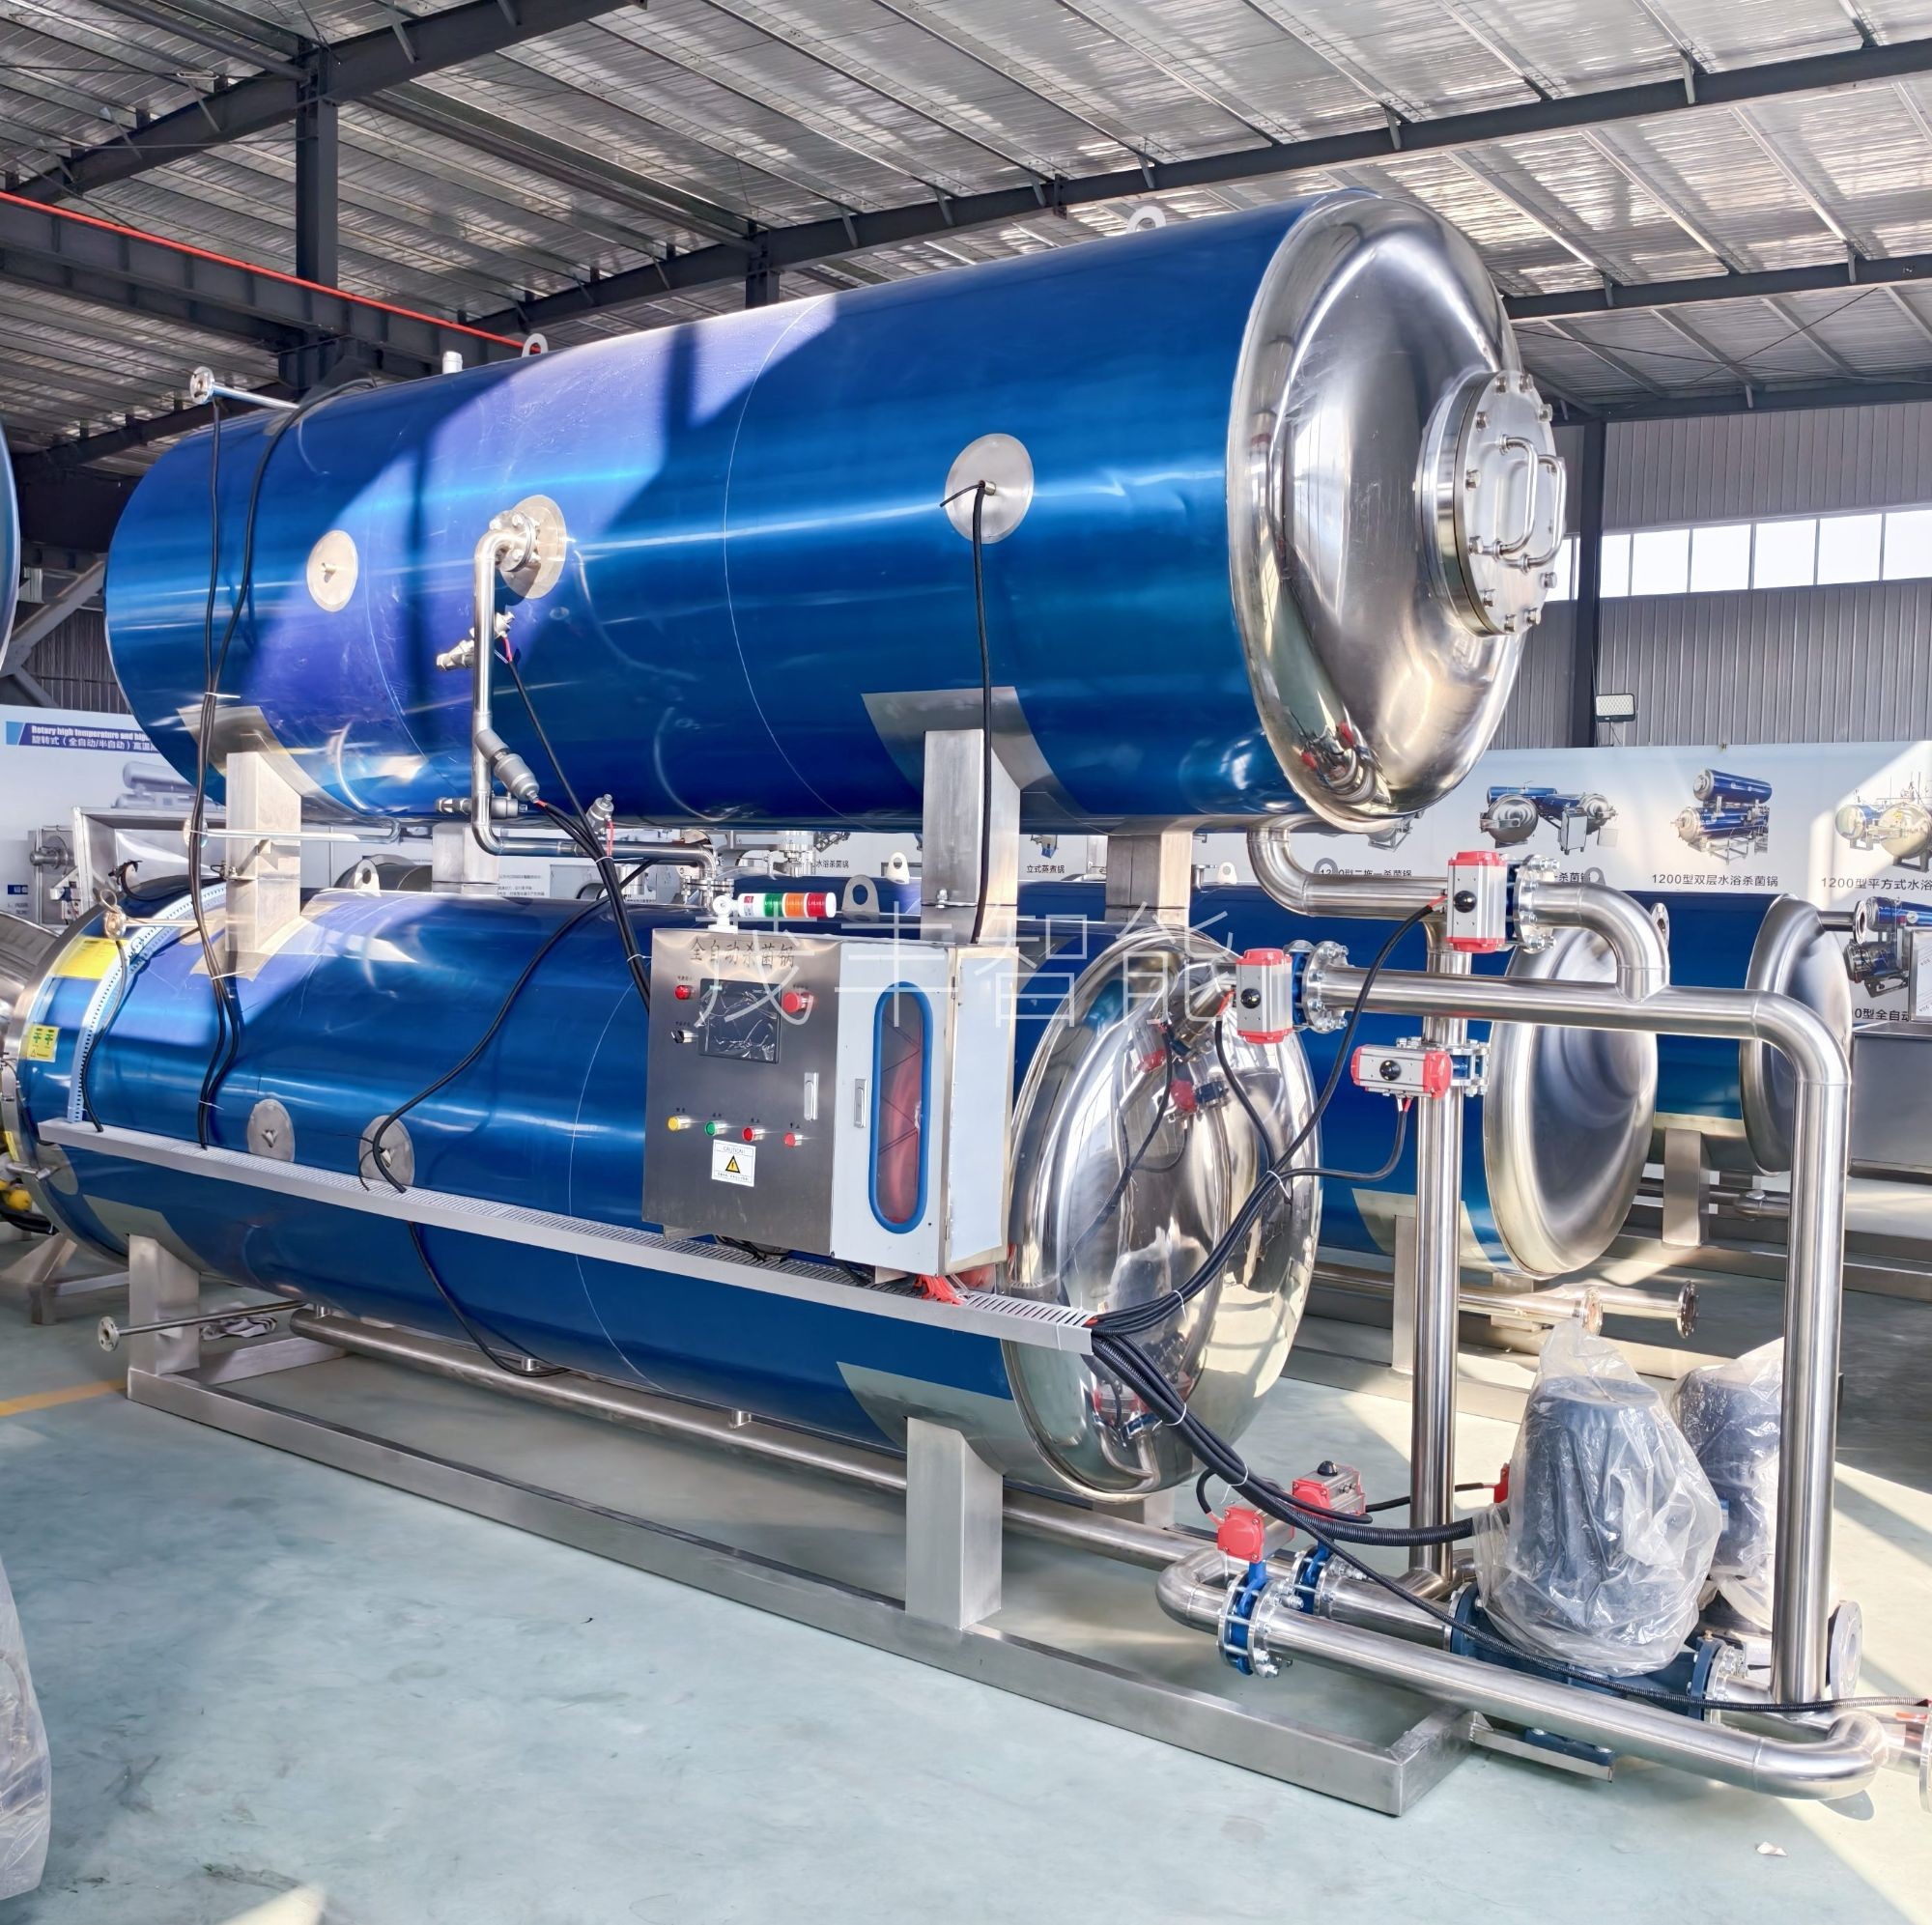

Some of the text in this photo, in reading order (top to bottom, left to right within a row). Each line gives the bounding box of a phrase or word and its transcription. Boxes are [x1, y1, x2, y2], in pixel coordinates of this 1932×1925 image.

[31, 725, 56, 736] Rotary
[56, 727, 74, 737] high
[74, 729, 120, 740] temperature
[120, 732, 133, 741] and
[1652, 874, 1778, 888] 1200型双层水浴杀菌锅
[1821, 877, 1932, 891] 1200型平方式水浴
[691, 937, 795, 968] 全自动杀菌锅
[1852, 1007, 1911, 1022] 0型全自动
